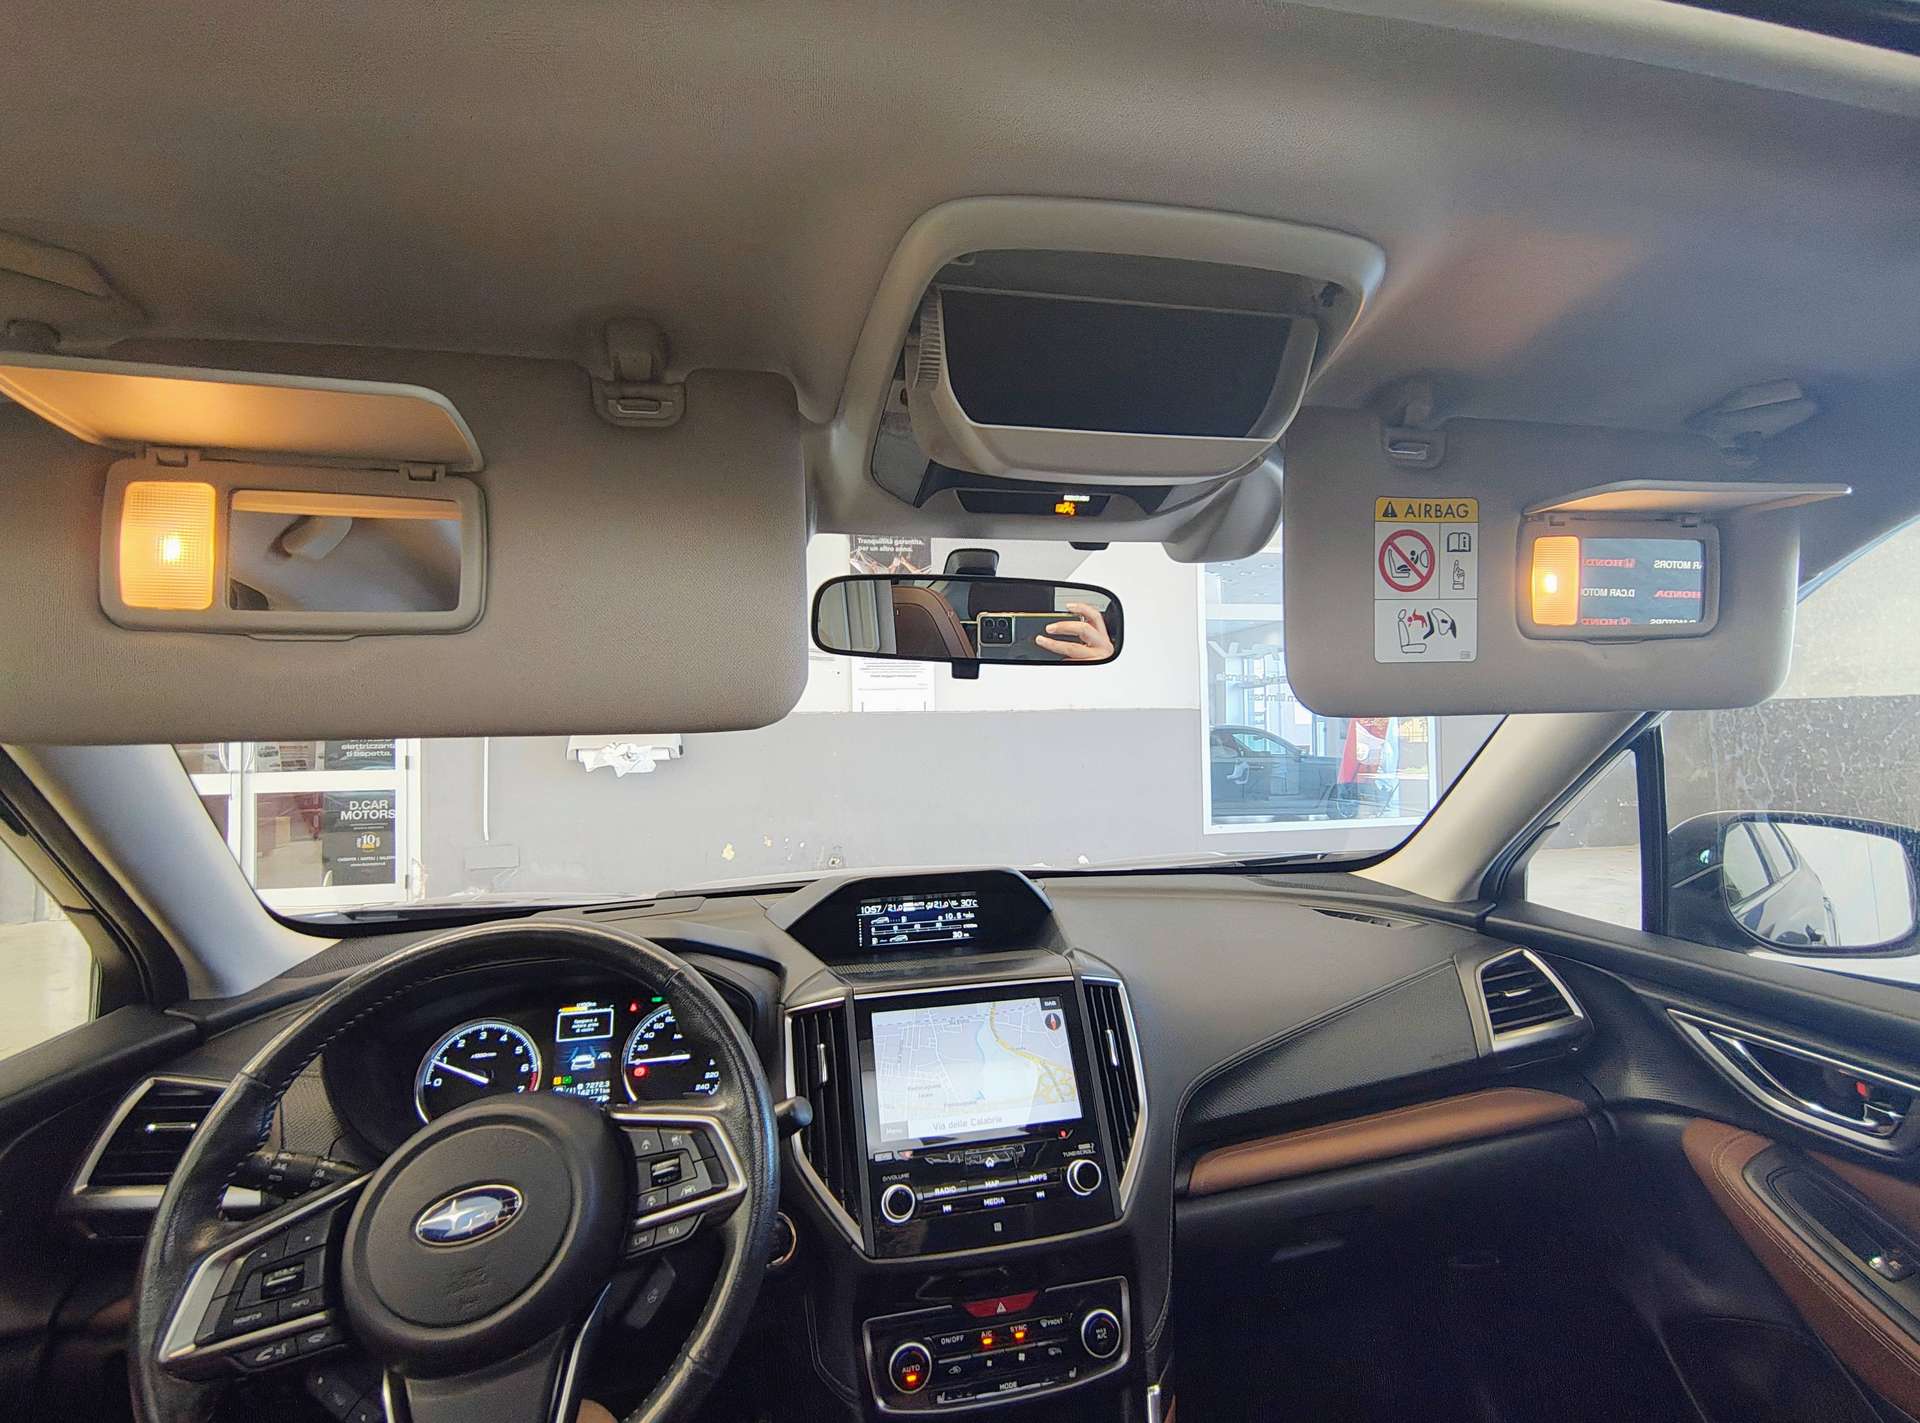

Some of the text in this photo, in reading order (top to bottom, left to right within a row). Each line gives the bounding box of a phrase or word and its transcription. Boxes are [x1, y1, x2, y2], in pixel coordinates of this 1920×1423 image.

[1404, 503, 1469, 519] AIRBAG
[349, 799, 389, 811] D.CAR
[340, 808, 396, 821] MOTORS
[480, 1031, 488, 1040] 3
[499, 1034, 508, 1042] 4
[643, 1031, 655, 1039] 40
[457, 1039, 466, 1048] 2
[636, 1043, 649, 1051] 20
[514, 1045, 524, 1055] 5
[520, 1063, 529, 1073] 6
[704, 1071, 719, 1079] 220
[433, 1078, 443, 1087] 0
[517, 1085, 525, 1093] 7
[932, 1123, 946, 1131] Via
[1029, 1173, 1048, 1182] APPS
[984, 1179, 1000, 1188] MAP
[934, 1185, 957, 1195] RADIO
[983, 1197, 1006, 1206] MEDIA
[1009, 1323, 1028, 1332] SYNC
[980, 1330, 993, 1338] A/C
[940, 1334, 965, 1345] ON/OFF
[901, 1363, 921, 1374] AUTO
[999, 1381, 1018, 1391] MODE
